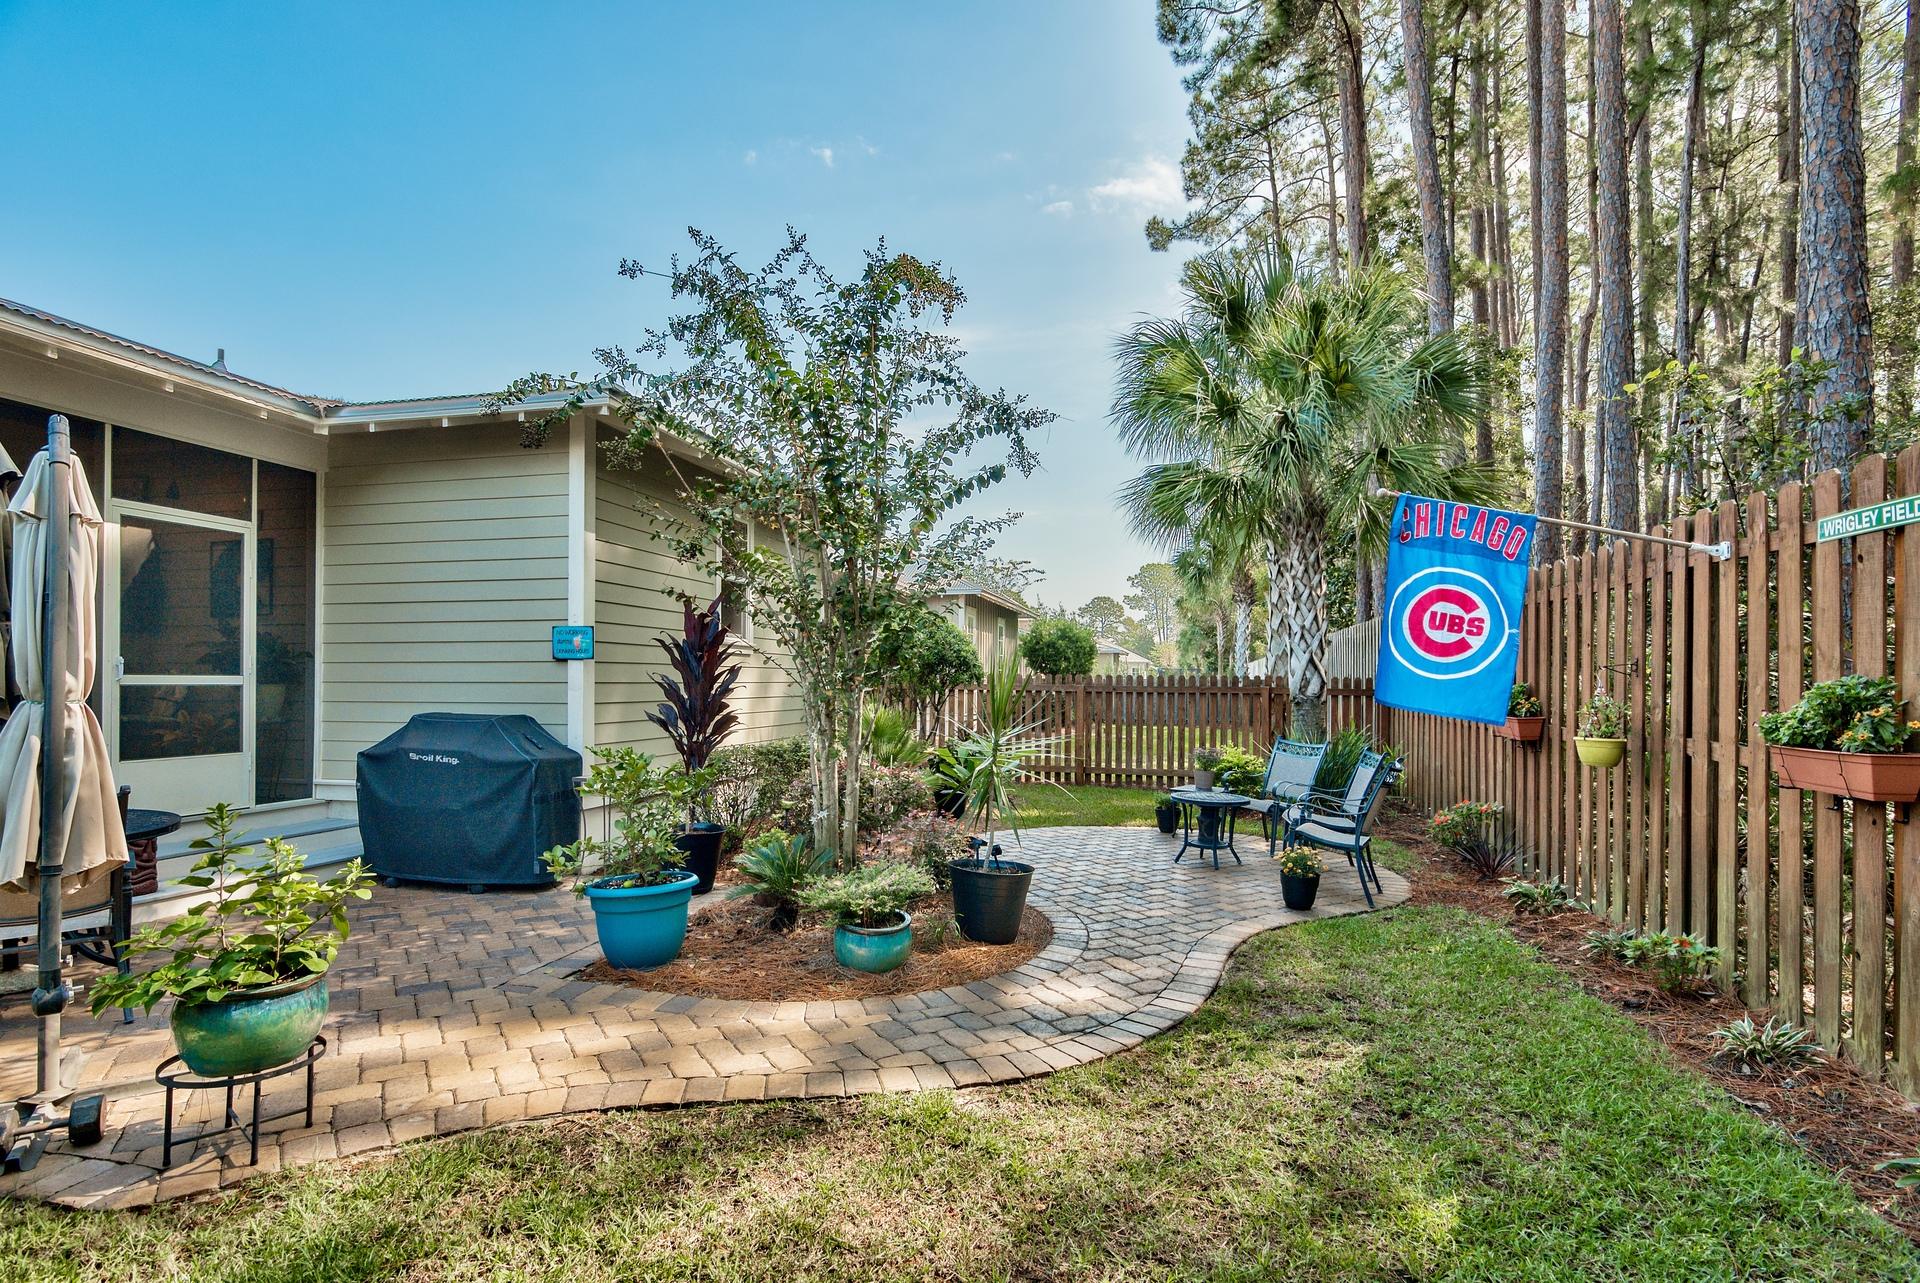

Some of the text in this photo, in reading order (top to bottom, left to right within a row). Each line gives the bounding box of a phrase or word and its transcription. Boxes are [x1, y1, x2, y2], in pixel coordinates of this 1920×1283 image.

[1400, 502, 1527, 561] CHICAGO
[1823, 509, 1879, 537] WRIGLEY
[1408, 588, 1485, 658] CUBS
[409, 752, 458, 765] Broil King
